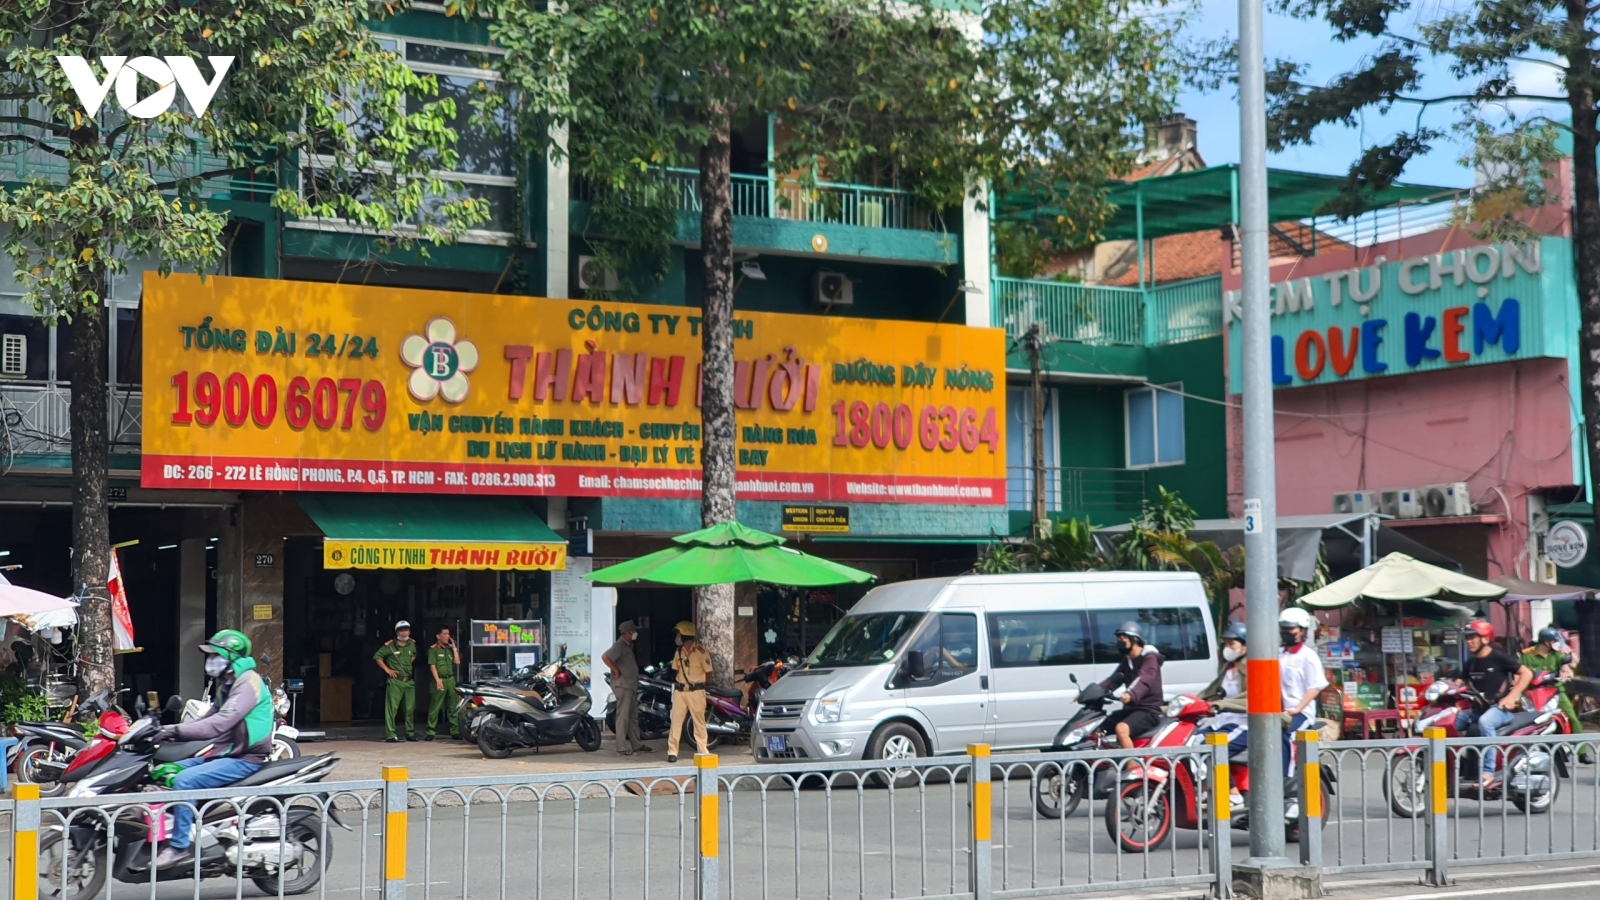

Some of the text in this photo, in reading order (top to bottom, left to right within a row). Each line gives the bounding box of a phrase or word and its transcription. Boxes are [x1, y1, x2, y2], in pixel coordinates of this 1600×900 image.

[1223, 240, 1540, 323] KM TỰ CHỌN
[180, 316, 379, 357] TỔNG ĐÀI 24/24
[568, 305, 753, 340] CÔNG TY TH
[1271, 298, 1520, 384] LOVE KEM
[504, 340, 820, 411] THÀNH ƯỞI
[833, 358, 994, 390] ĐƯỜNG DÂY NÓNG
[171, 371, 388, 431] 1900 6079
[408, 410, 443, 435] VẬN
[520, 415, 564, 435] HÀNH
[570, 417, 624, 438] KHÁCH
[743, 423, 783, 443] HÀNG
[787, 425, 817, 444] HÓA
[833, 400, 998, 452] 1800 6364
[467, 440, 490, 458] DU
[496, 441, 532, 462] LỊCH
[562, 440, 606, 461] HÀNH
[620, 445, 647, 466] ĐẠI
[653, 443, 669, 463] LÝ
[675, 444, 695, 464] VÉ
[739, 448, 769, 465] BAY
[163, 465, 185, 479] ĐC:
[188, 465, 213, 480] 266
[224, 466, 246, 480] 272
[250, 464, 262, 481] LÊ
[265, 462, 298, 481] HỒNG
[302, 468, 345, 483] PHONG,
[391, 471, 405, 484] TP.
[409, 471, 434, 485] HCM
[445, 471, 468, 485] FAX:
[472, 472, 556, 488] 0286.2.908.313
[579, 475, 611, 489] Email:
[846, 482, 993, 498] Website: www.thanhbuoi.com.vn
[1246, 515, 1254, 531] 3
[256, 555, 273, 564] 270
[351, 545, 557, 565] CÔNG TY TNHH THÀNH BƯỞI
